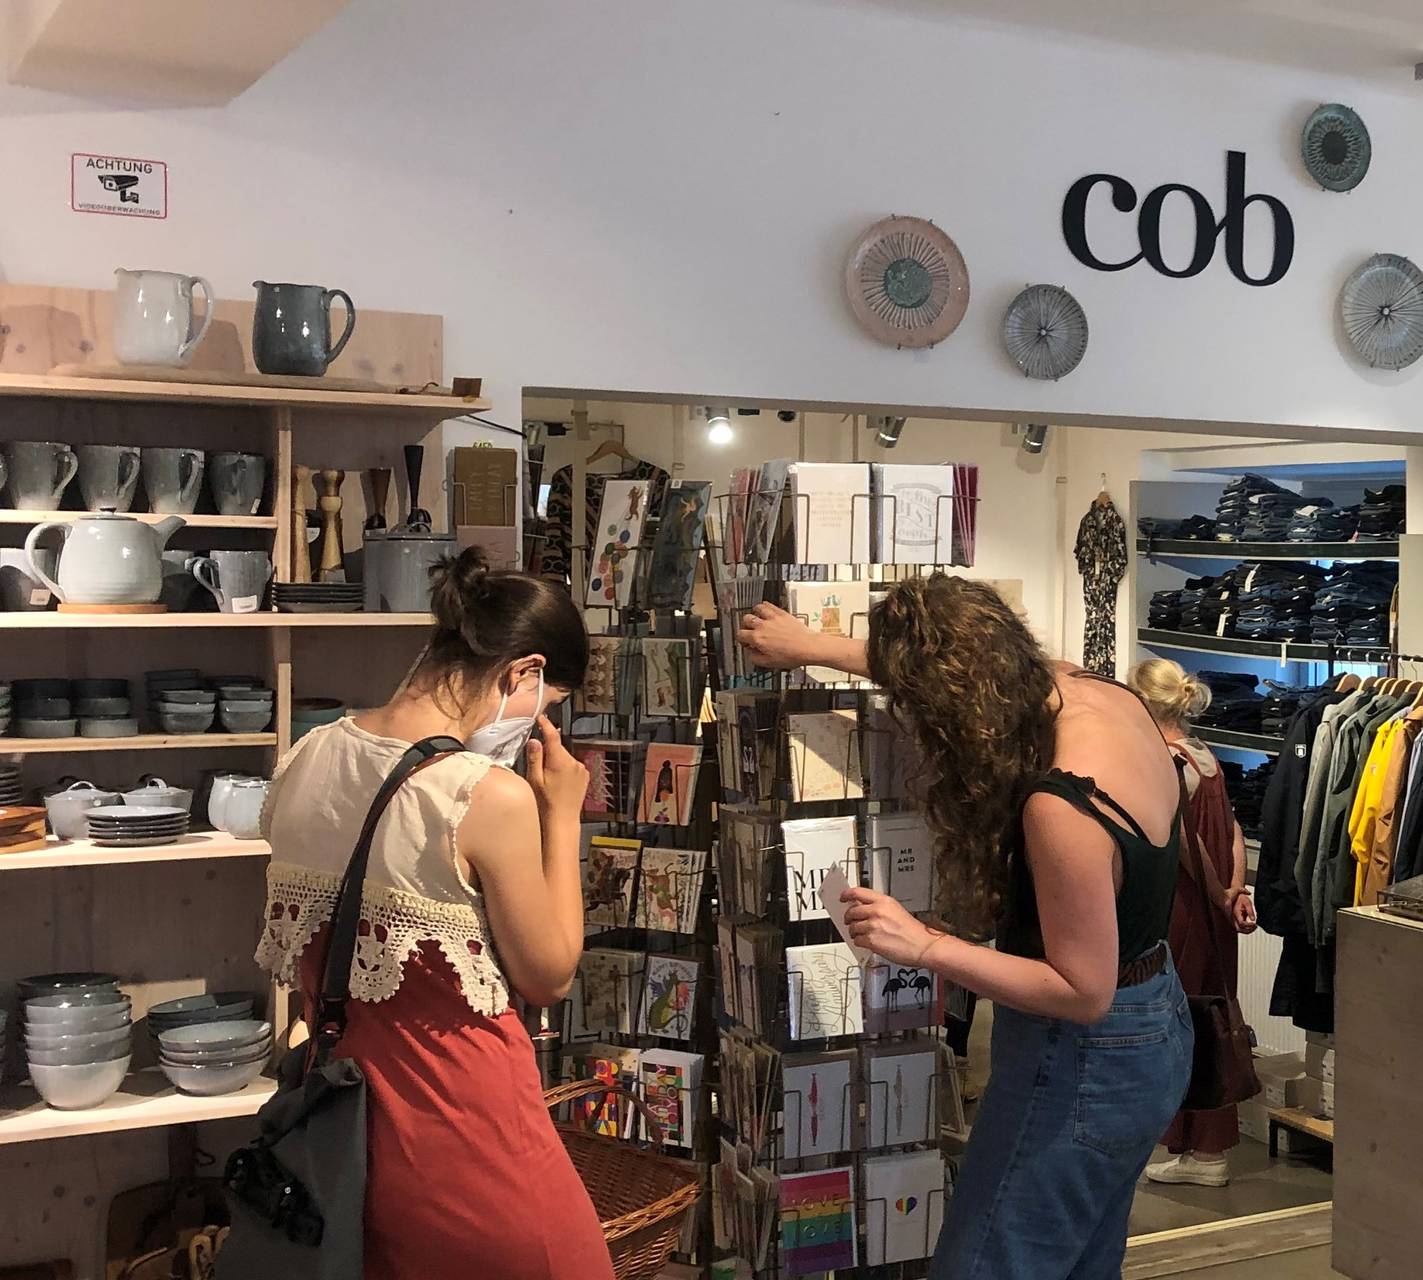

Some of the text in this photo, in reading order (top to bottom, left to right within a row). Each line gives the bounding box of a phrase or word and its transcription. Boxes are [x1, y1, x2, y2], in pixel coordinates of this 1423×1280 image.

[86, 158, 153, 174] ACHTUNG
[1062, 150, 1295, 287] cob
[900, 848, 913, 856] MR
